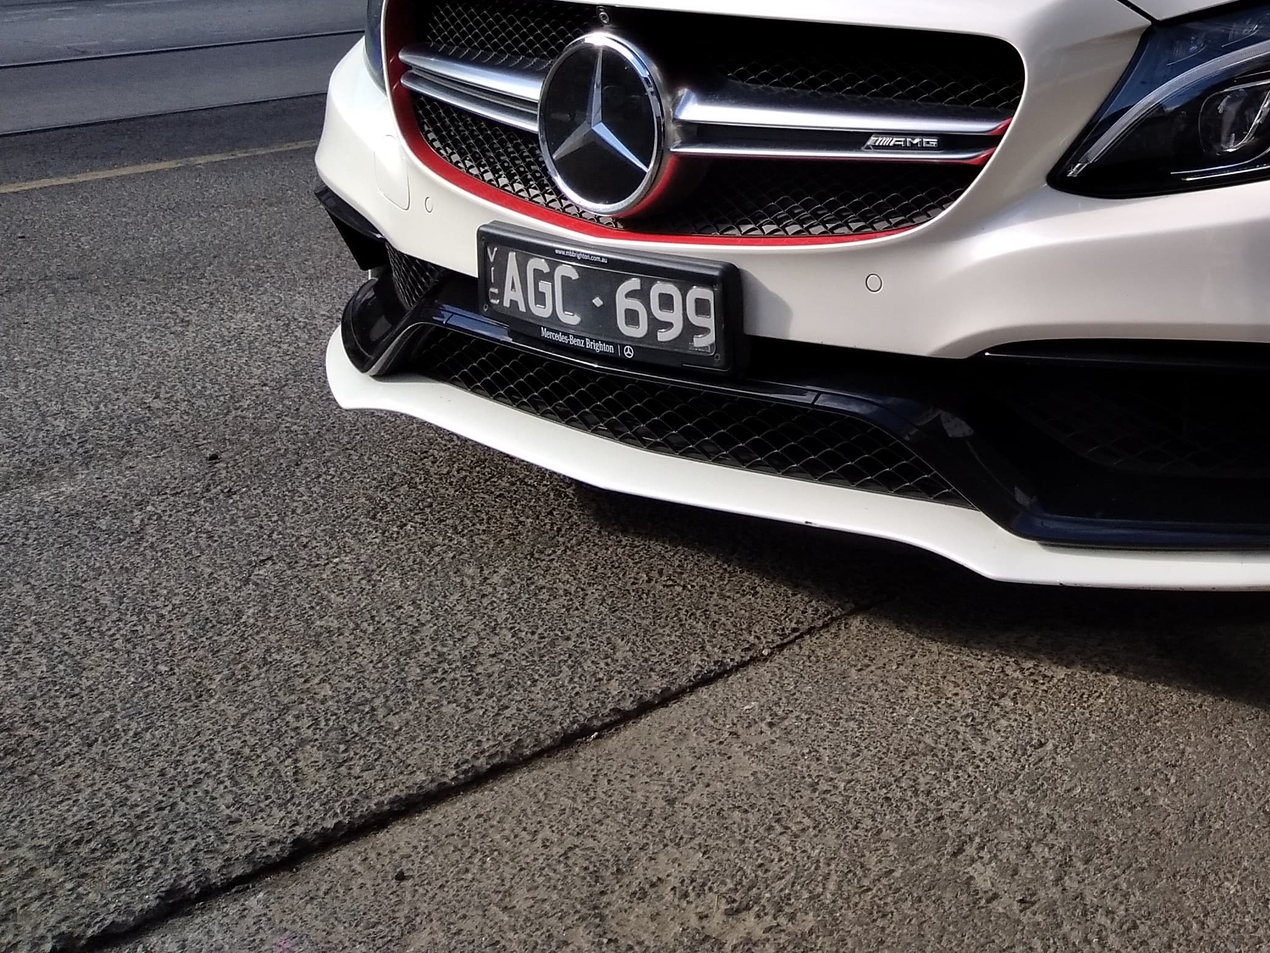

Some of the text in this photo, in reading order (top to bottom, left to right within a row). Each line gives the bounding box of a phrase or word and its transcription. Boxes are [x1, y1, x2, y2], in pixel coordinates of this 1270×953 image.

[503, 251, 716, 348] AGC 699
[540, 327, 615, 353] Mercedes-Benz Brighton
